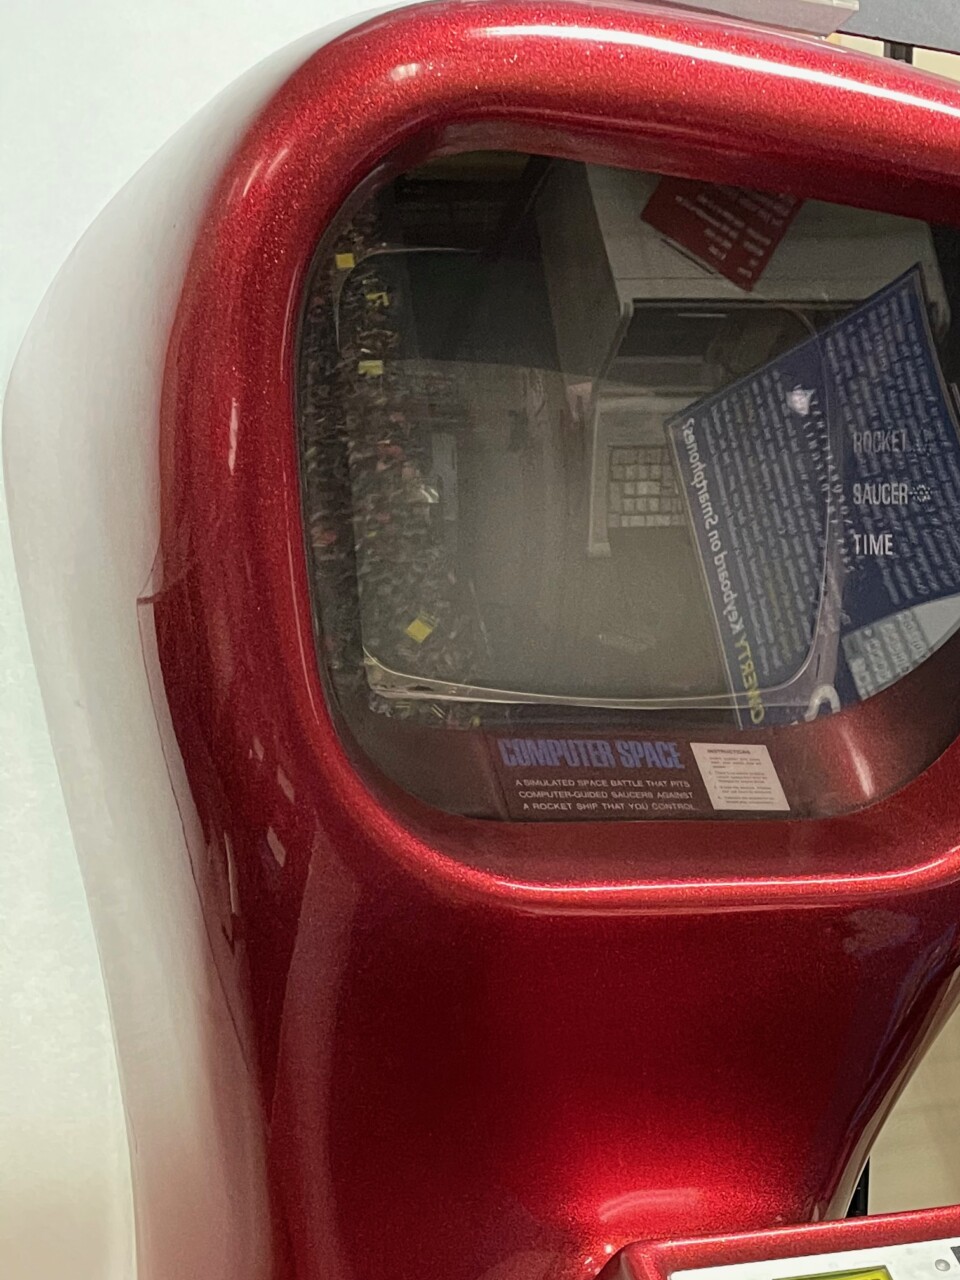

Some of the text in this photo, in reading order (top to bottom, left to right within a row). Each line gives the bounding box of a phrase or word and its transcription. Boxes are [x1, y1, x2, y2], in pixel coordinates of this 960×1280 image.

[853, 430, 907, 453] ROCKET
[853, 482, 908, 505] SAUCER
[853, 533, 893, 555] TIME
[497, 738, 686, 769] COMPUTER SPACE
[524, 779, 575, 787] SIMULATED
[577, 779, 608, 788] SPACE
[610, 780, 644, 788] BATTLE
[646, 780, 668, 788] THAT
[670, 780, 691, 788] PITS
[518, 791, 608, 799] COMPUTER-GUIDED
[611, 791, 654, 799] SAUCERS
[523, 802, 529, 810] A
[532, 802, 572, 810] ROCKET
[576, 802, 598, 810] SHIP
[602, 802, 625, 810] THAT
[628, 802, 648, 811] YOU
